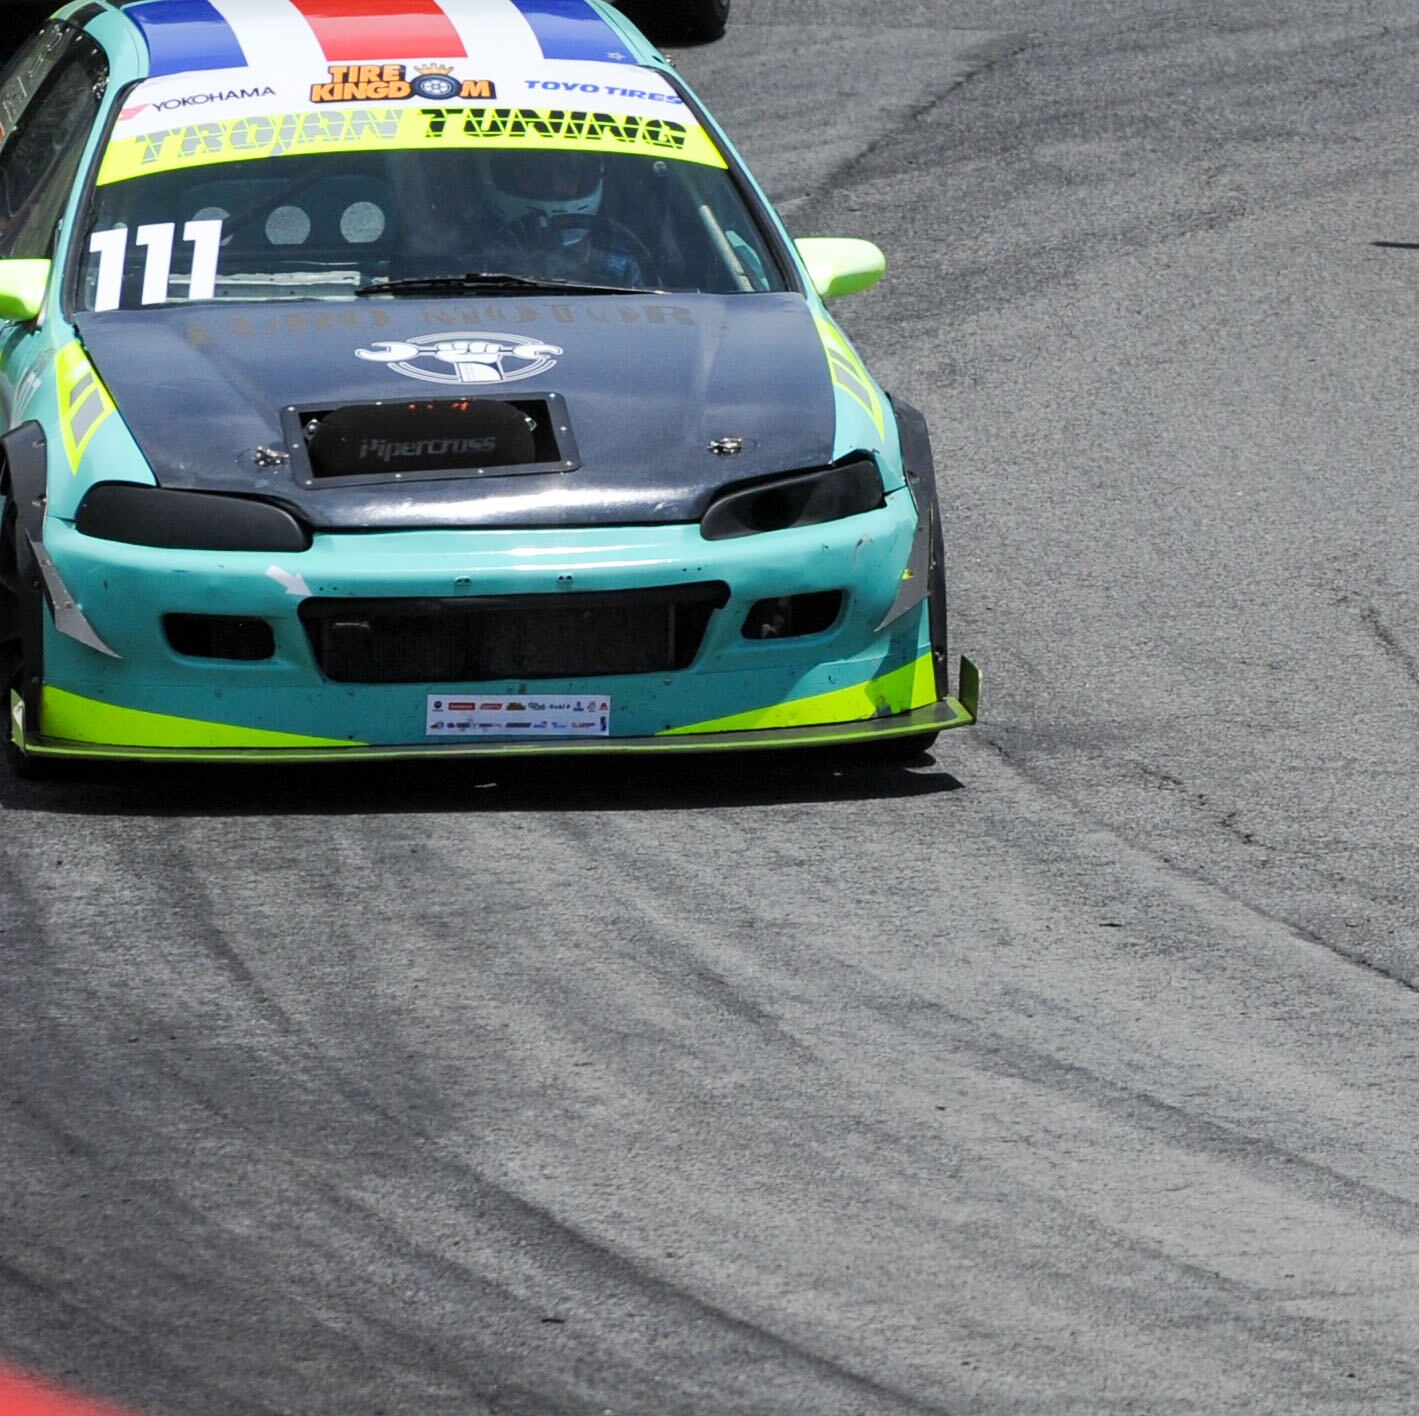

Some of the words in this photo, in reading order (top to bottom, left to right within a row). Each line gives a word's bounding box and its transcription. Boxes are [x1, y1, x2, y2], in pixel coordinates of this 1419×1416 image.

[328, 64, 405, 82] TIRE
[152, 86, 277, 112] YOKOHAMA
[525, 80, 601, 95] TOYO
[604, 86, 685, 105] TIRES
[136, 108, 402, 164] TROJAN
[419, 108, 688, 149] TUNING
[89, 220, 223, 312] 111
